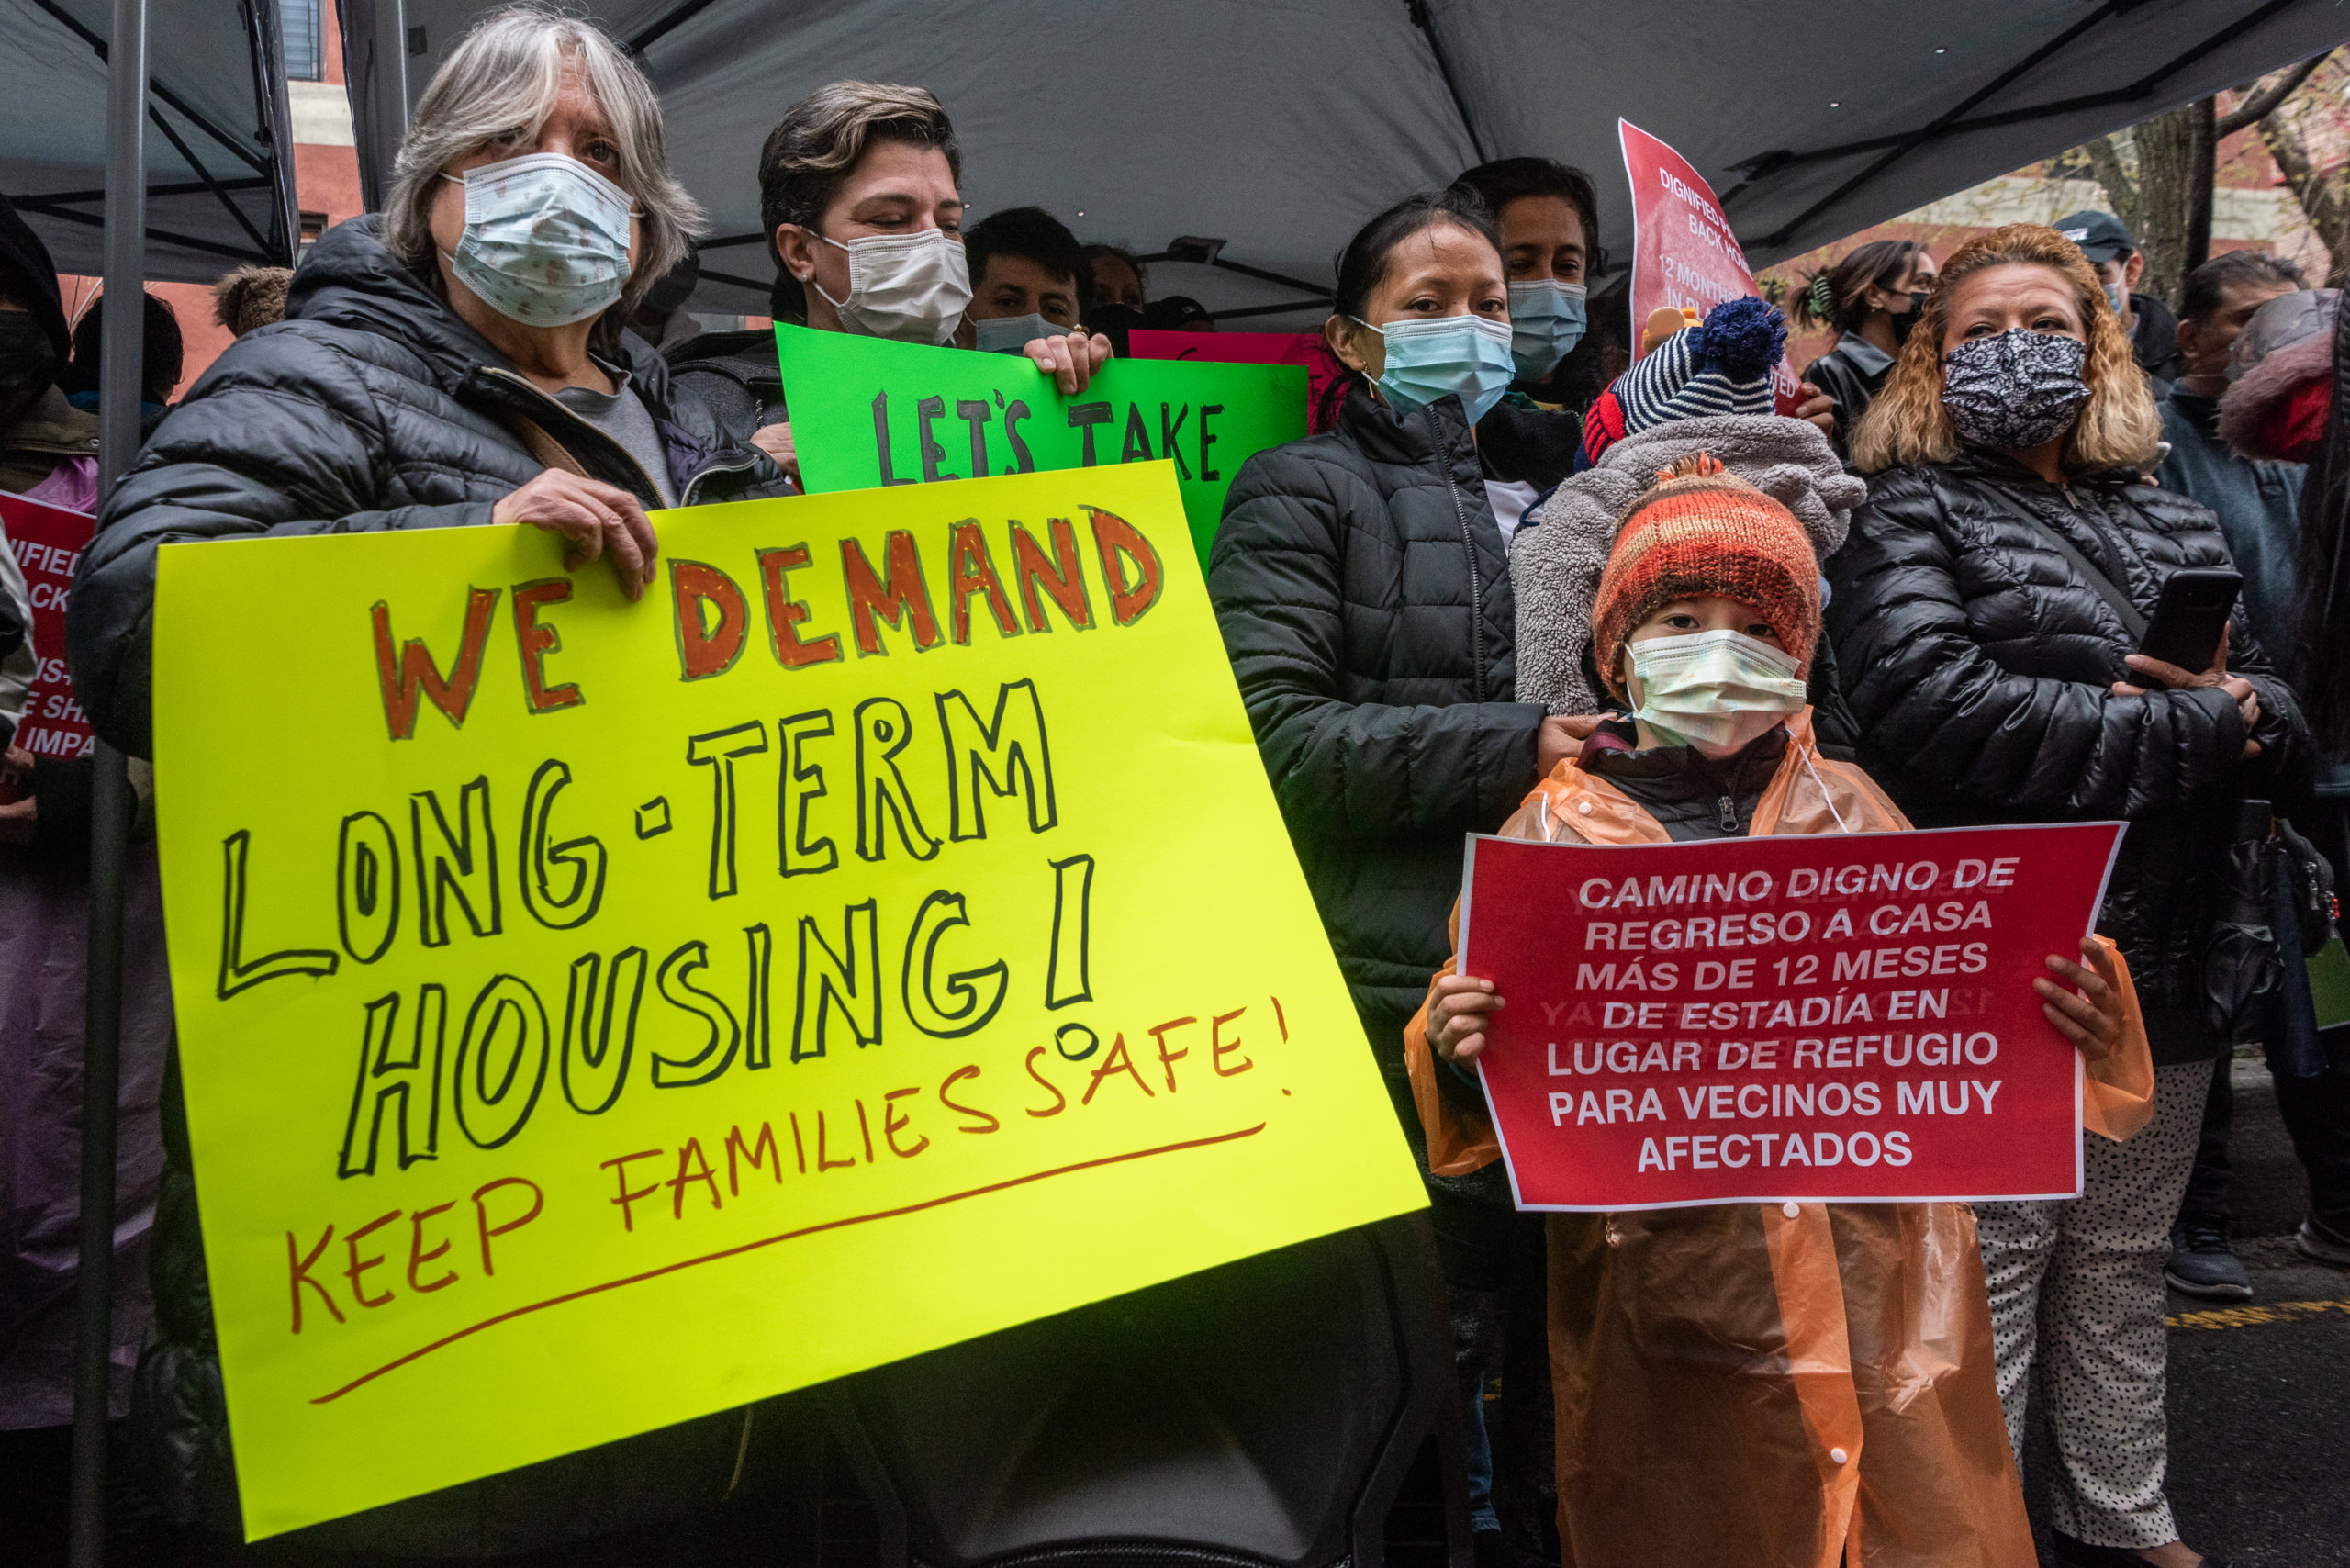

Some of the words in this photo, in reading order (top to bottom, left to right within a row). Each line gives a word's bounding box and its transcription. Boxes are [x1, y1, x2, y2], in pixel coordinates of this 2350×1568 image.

[1659, 167, 1719, 227] DIGNIFIED
[1688, 213, 1724, 253] BACK
[1659, 253, 1673, 279] 12
[871, 389, 1035, 487] LET'S
[1067, 401, 1225, 482] TAKE
[371, 577, 585, 741] WE
[667, 505, 1164, 681] DEMAND
[217, 678, 1058, 1000] LONG-TERM
[1580, 871, 1772, 909] CAMINO
[1786, 861, 1940, 898] DIGNO
[1952, 857, 2020, 889] DE
[1585, 911, 1811, 951] REGRESO
[1823, 909, 1854, 939] A
[1870, 901, 1992, 935] CASA
[1576, 957, 1679, 991] MÁS
[1694, 959, 1757, 991] DE
[1773, 955, 1819, 986] 12
[1832, 943, 1988, 982] MESES
[337, 856, 1099, 1180] HOUSING!
[1604, 1002, 1667, 1029] DE
[1681, 987, 1874, 1030] ESTADÍA
[1888, 989, 1949, 1021] EN
[1548, 1042, 1702, 1077] LUGAR
[1717, 1041, 1780, 1070] DE
[1794, 1032, 1998, 1069] REFUGIO
[1549, 1087, 1667, 1127] PARA
[1678, 1081, 1882, 1120] VECINOS
[1897, 1080, 2003, 1115] MUY
[286, 1176, 544, 1335] KEEP
[599, 1064, 1001, 1232] FAMILIES
[1024, 995, 1292, 1118] SAFE!
[1638, 1131, 1913, 1173] AFECTADOS
